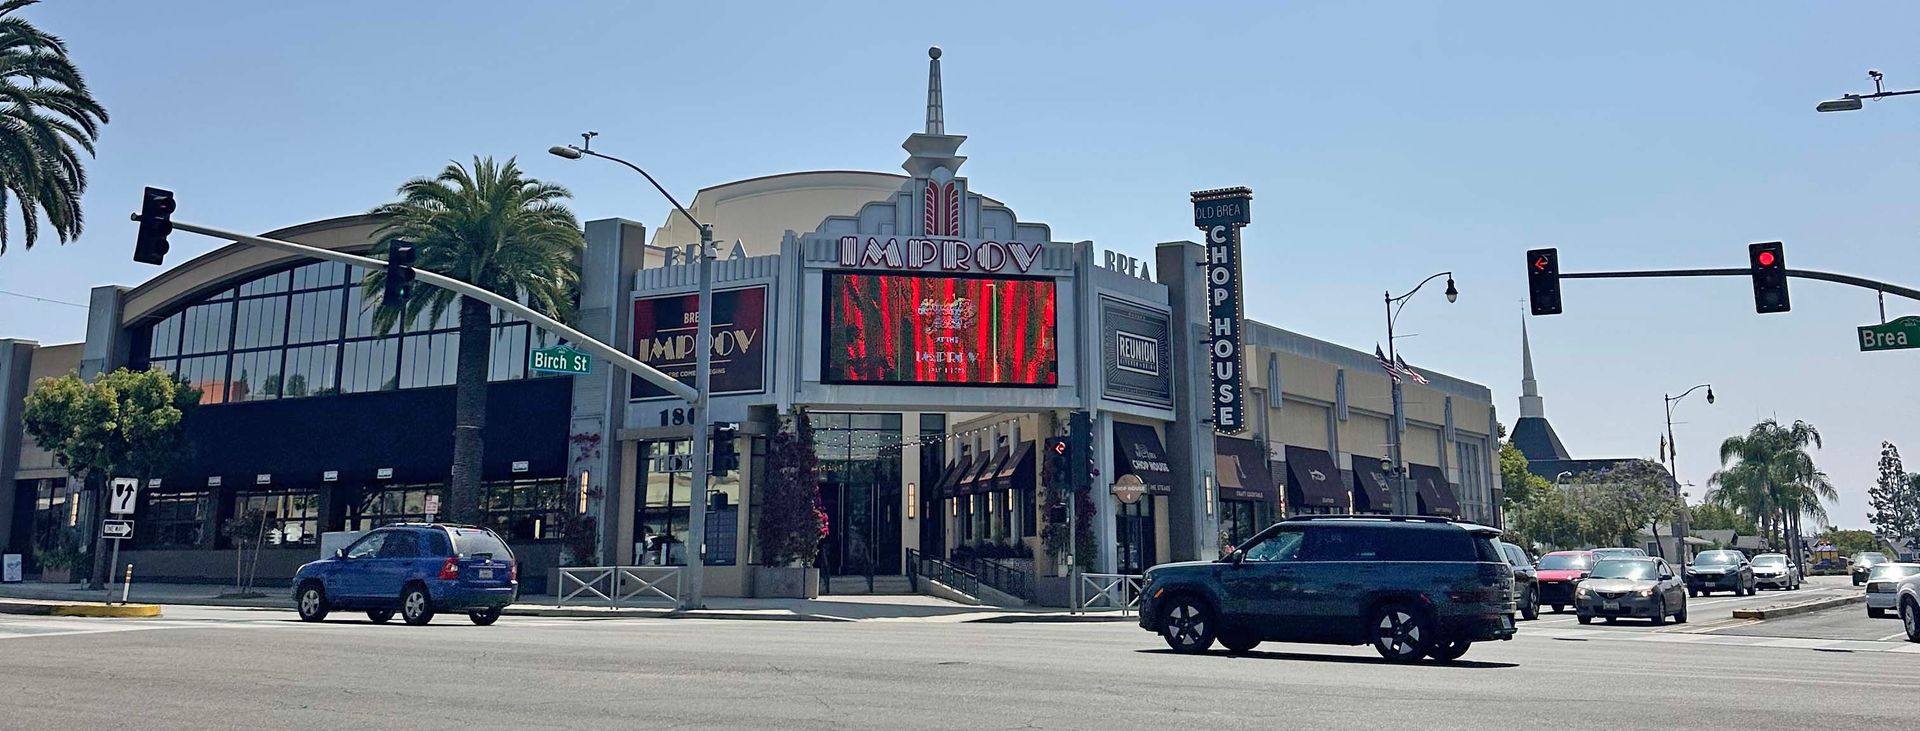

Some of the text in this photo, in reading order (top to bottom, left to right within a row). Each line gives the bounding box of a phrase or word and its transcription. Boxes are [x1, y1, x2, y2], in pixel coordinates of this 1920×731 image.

[1196, 204, 1241, 220] OLD BREA
[841, 236, 1041, 272] IMPROV
[1104, 250, 1151, 281] BREA
[1210, 225, 1234, 426] CHOP HOUSE
[1120, 336, 1156, 363] REUNION
[1862, 330, 1908, 348] Brea
[535, 351, 587, 372] Birch St
[1132, 460, 1170, 473] CHOP HOUSE
